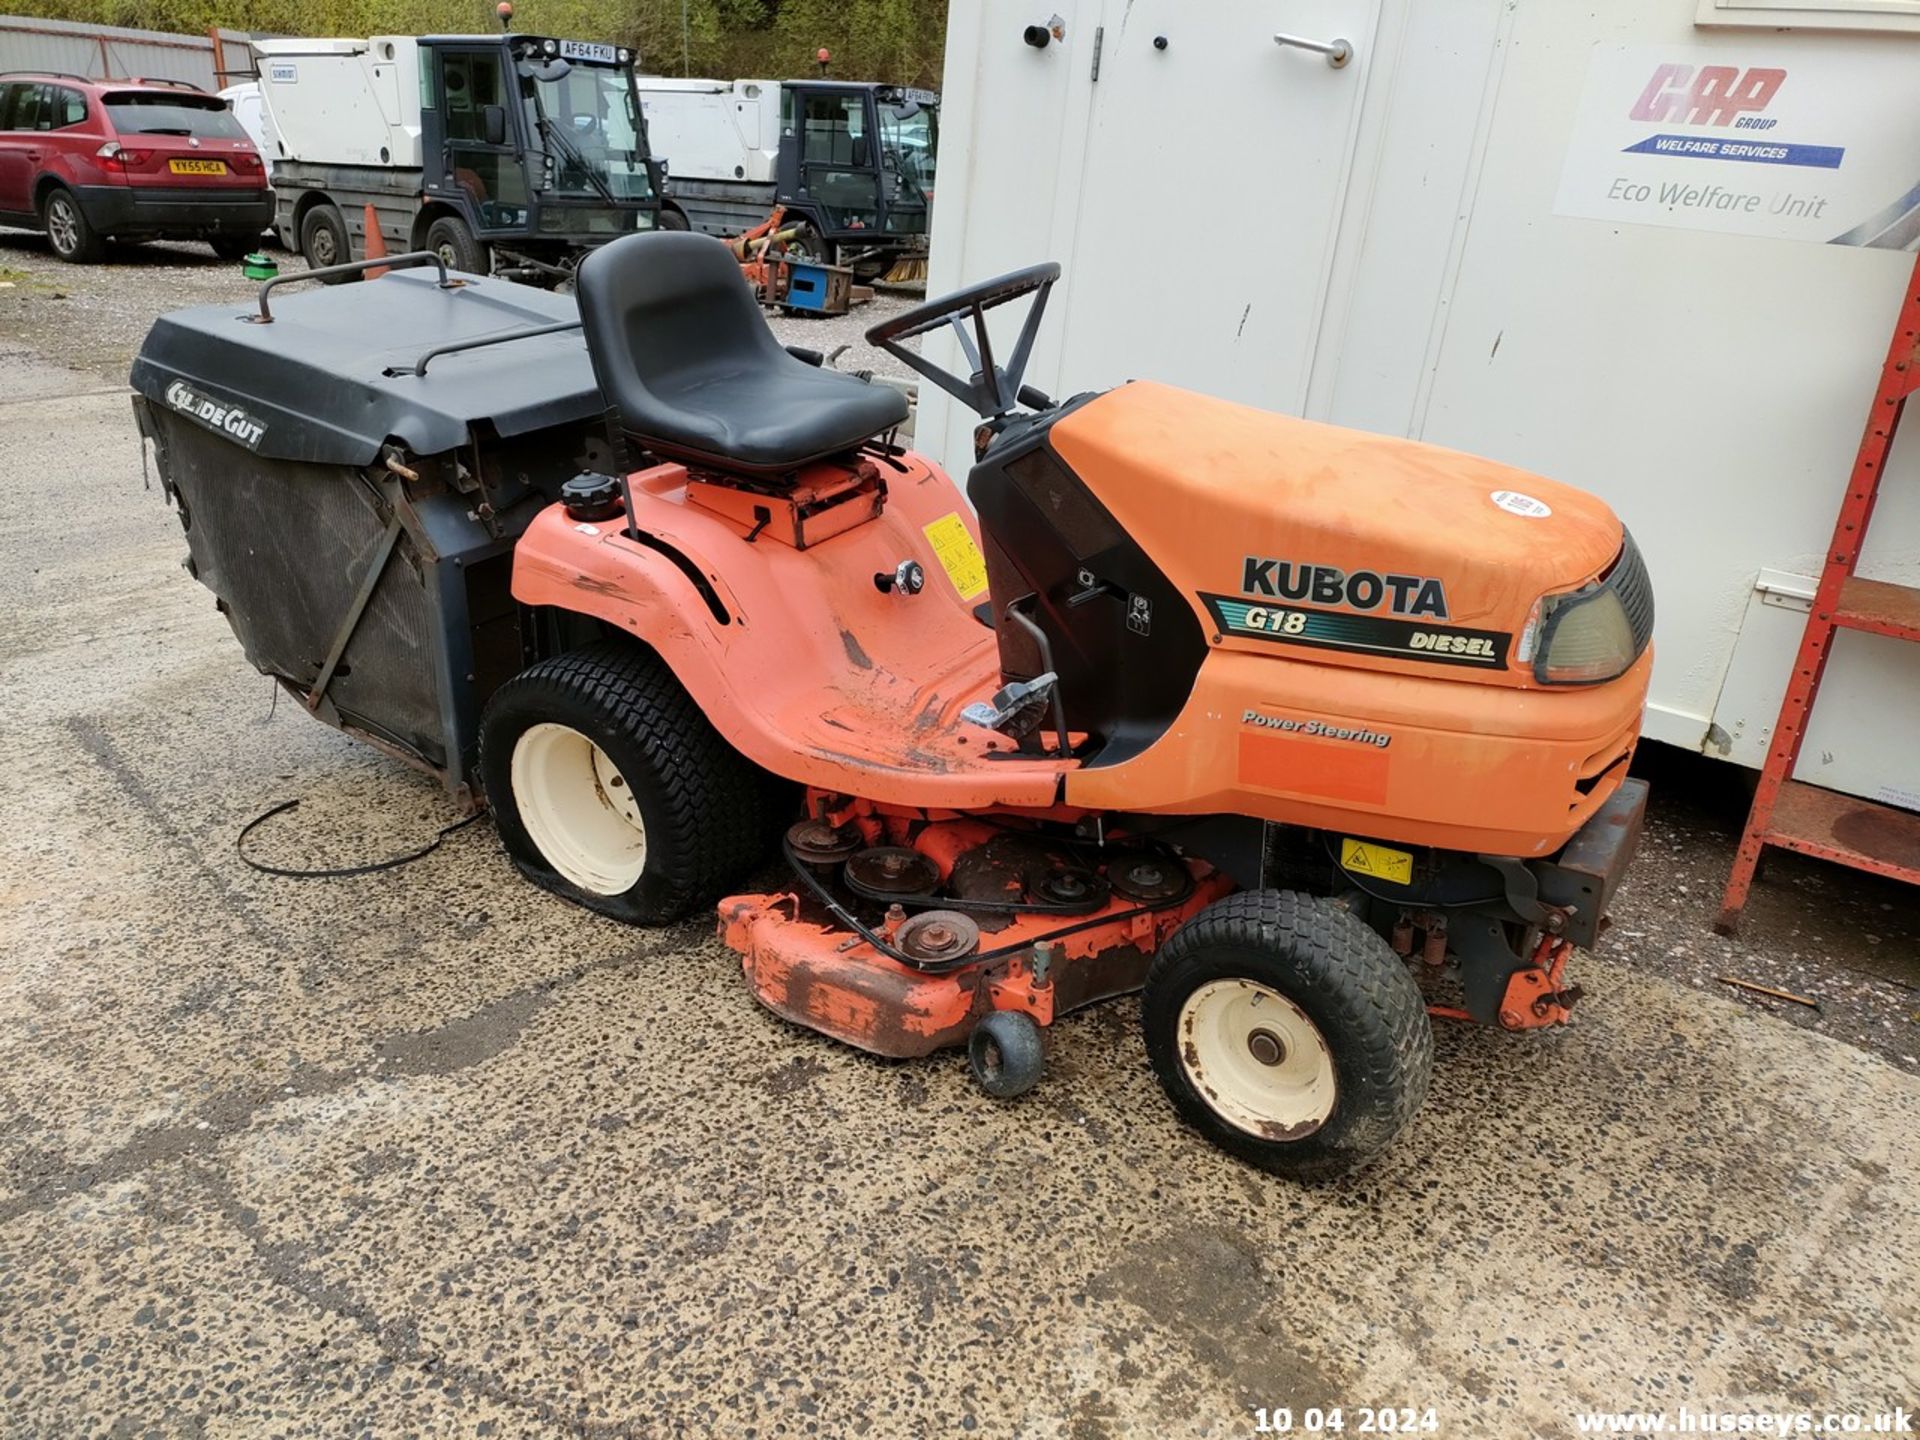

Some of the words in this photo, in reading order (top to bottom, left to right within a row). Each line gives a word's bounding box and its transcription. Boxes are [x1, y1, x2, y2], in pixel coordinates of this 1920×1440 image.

[565, 42, 591, 57] AF64
[593, 46, 613, 60] FKU
[1735, 116, 1778, 130] GROUP
[1655, 138, 1720, 155] WELFARE
[1720, 143, 1788, 160] SERVICES
[173, 160, 202, 172] YY55
[202, 162, 222, 173] HCA
[1607, 178, 1651, 202] Eco
[1659, 181, 1761, 213] Welfare
[1768, 192, 1829, 220] Unit
[1242, 555, 1451, 621] KUBOTA
[1245, 606, 1307, 635] G18
[1408, 632, 1496, 658] DIESEL
